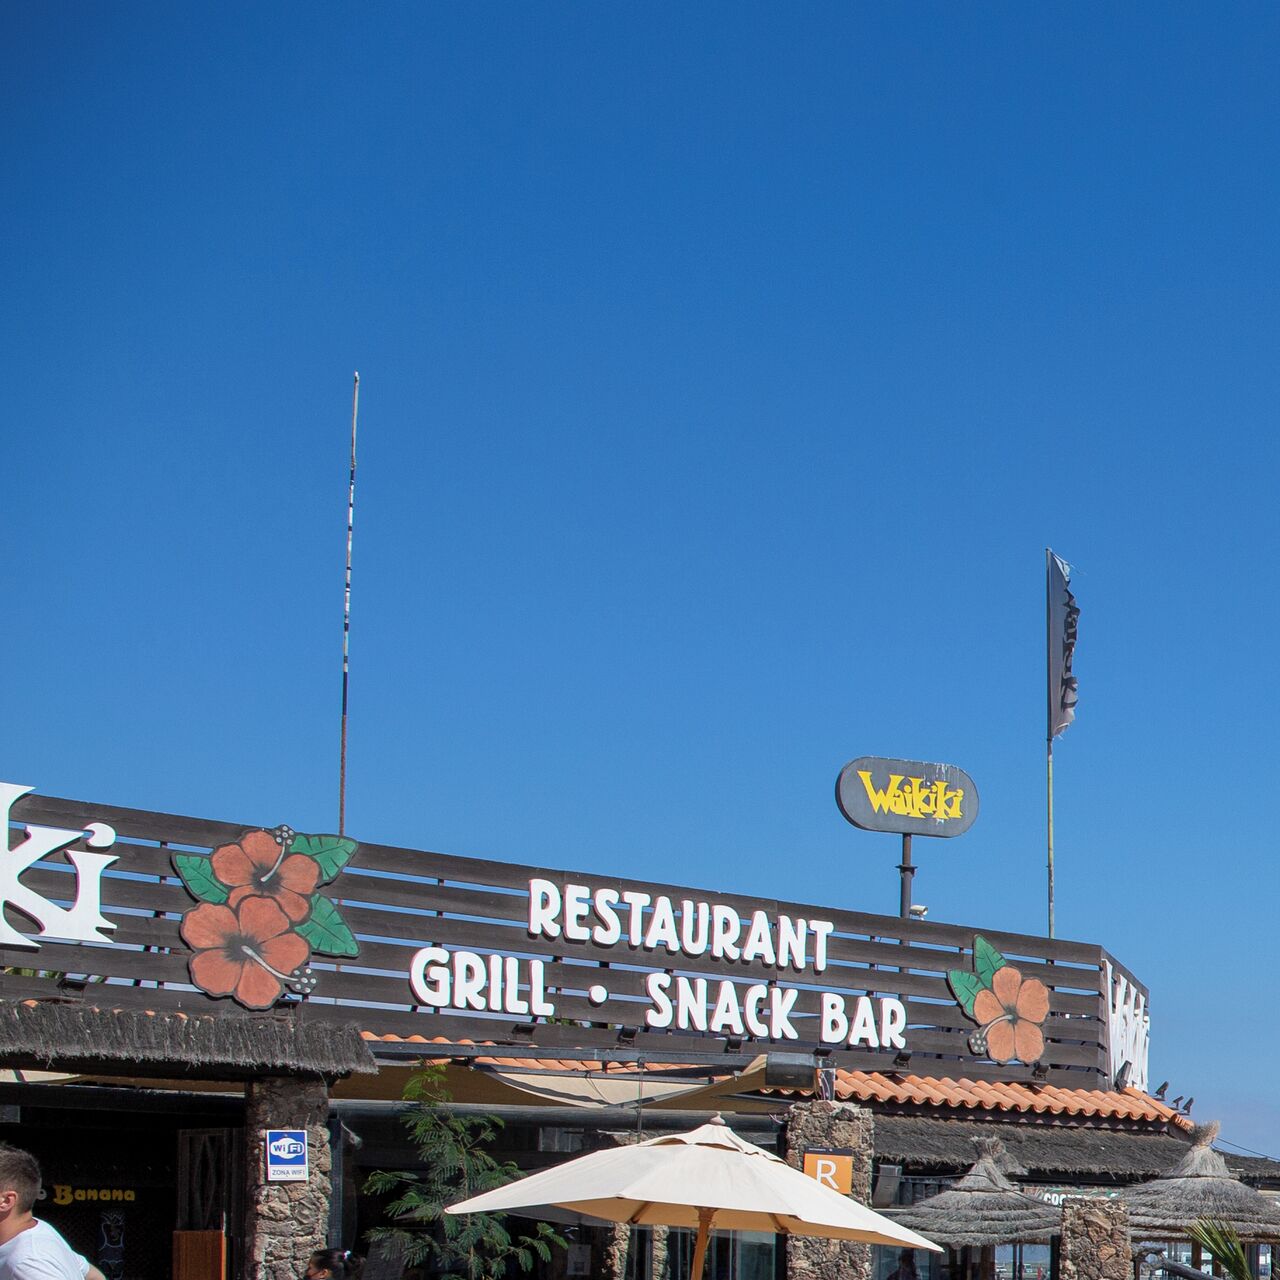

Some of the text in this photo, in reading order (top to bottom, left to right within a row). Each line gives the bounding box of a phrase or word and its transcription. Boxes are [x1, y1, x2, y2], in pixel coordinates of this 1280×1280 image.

[856, 769, 964, 820] Waikiki
[528, 878, 834, 972] RESTAURANT
[410, 946, 907, 1049] GRILL SNACK BAR
[53, 1184, 135, 1205] Banana
[816, 1160, 840, 1190] R
